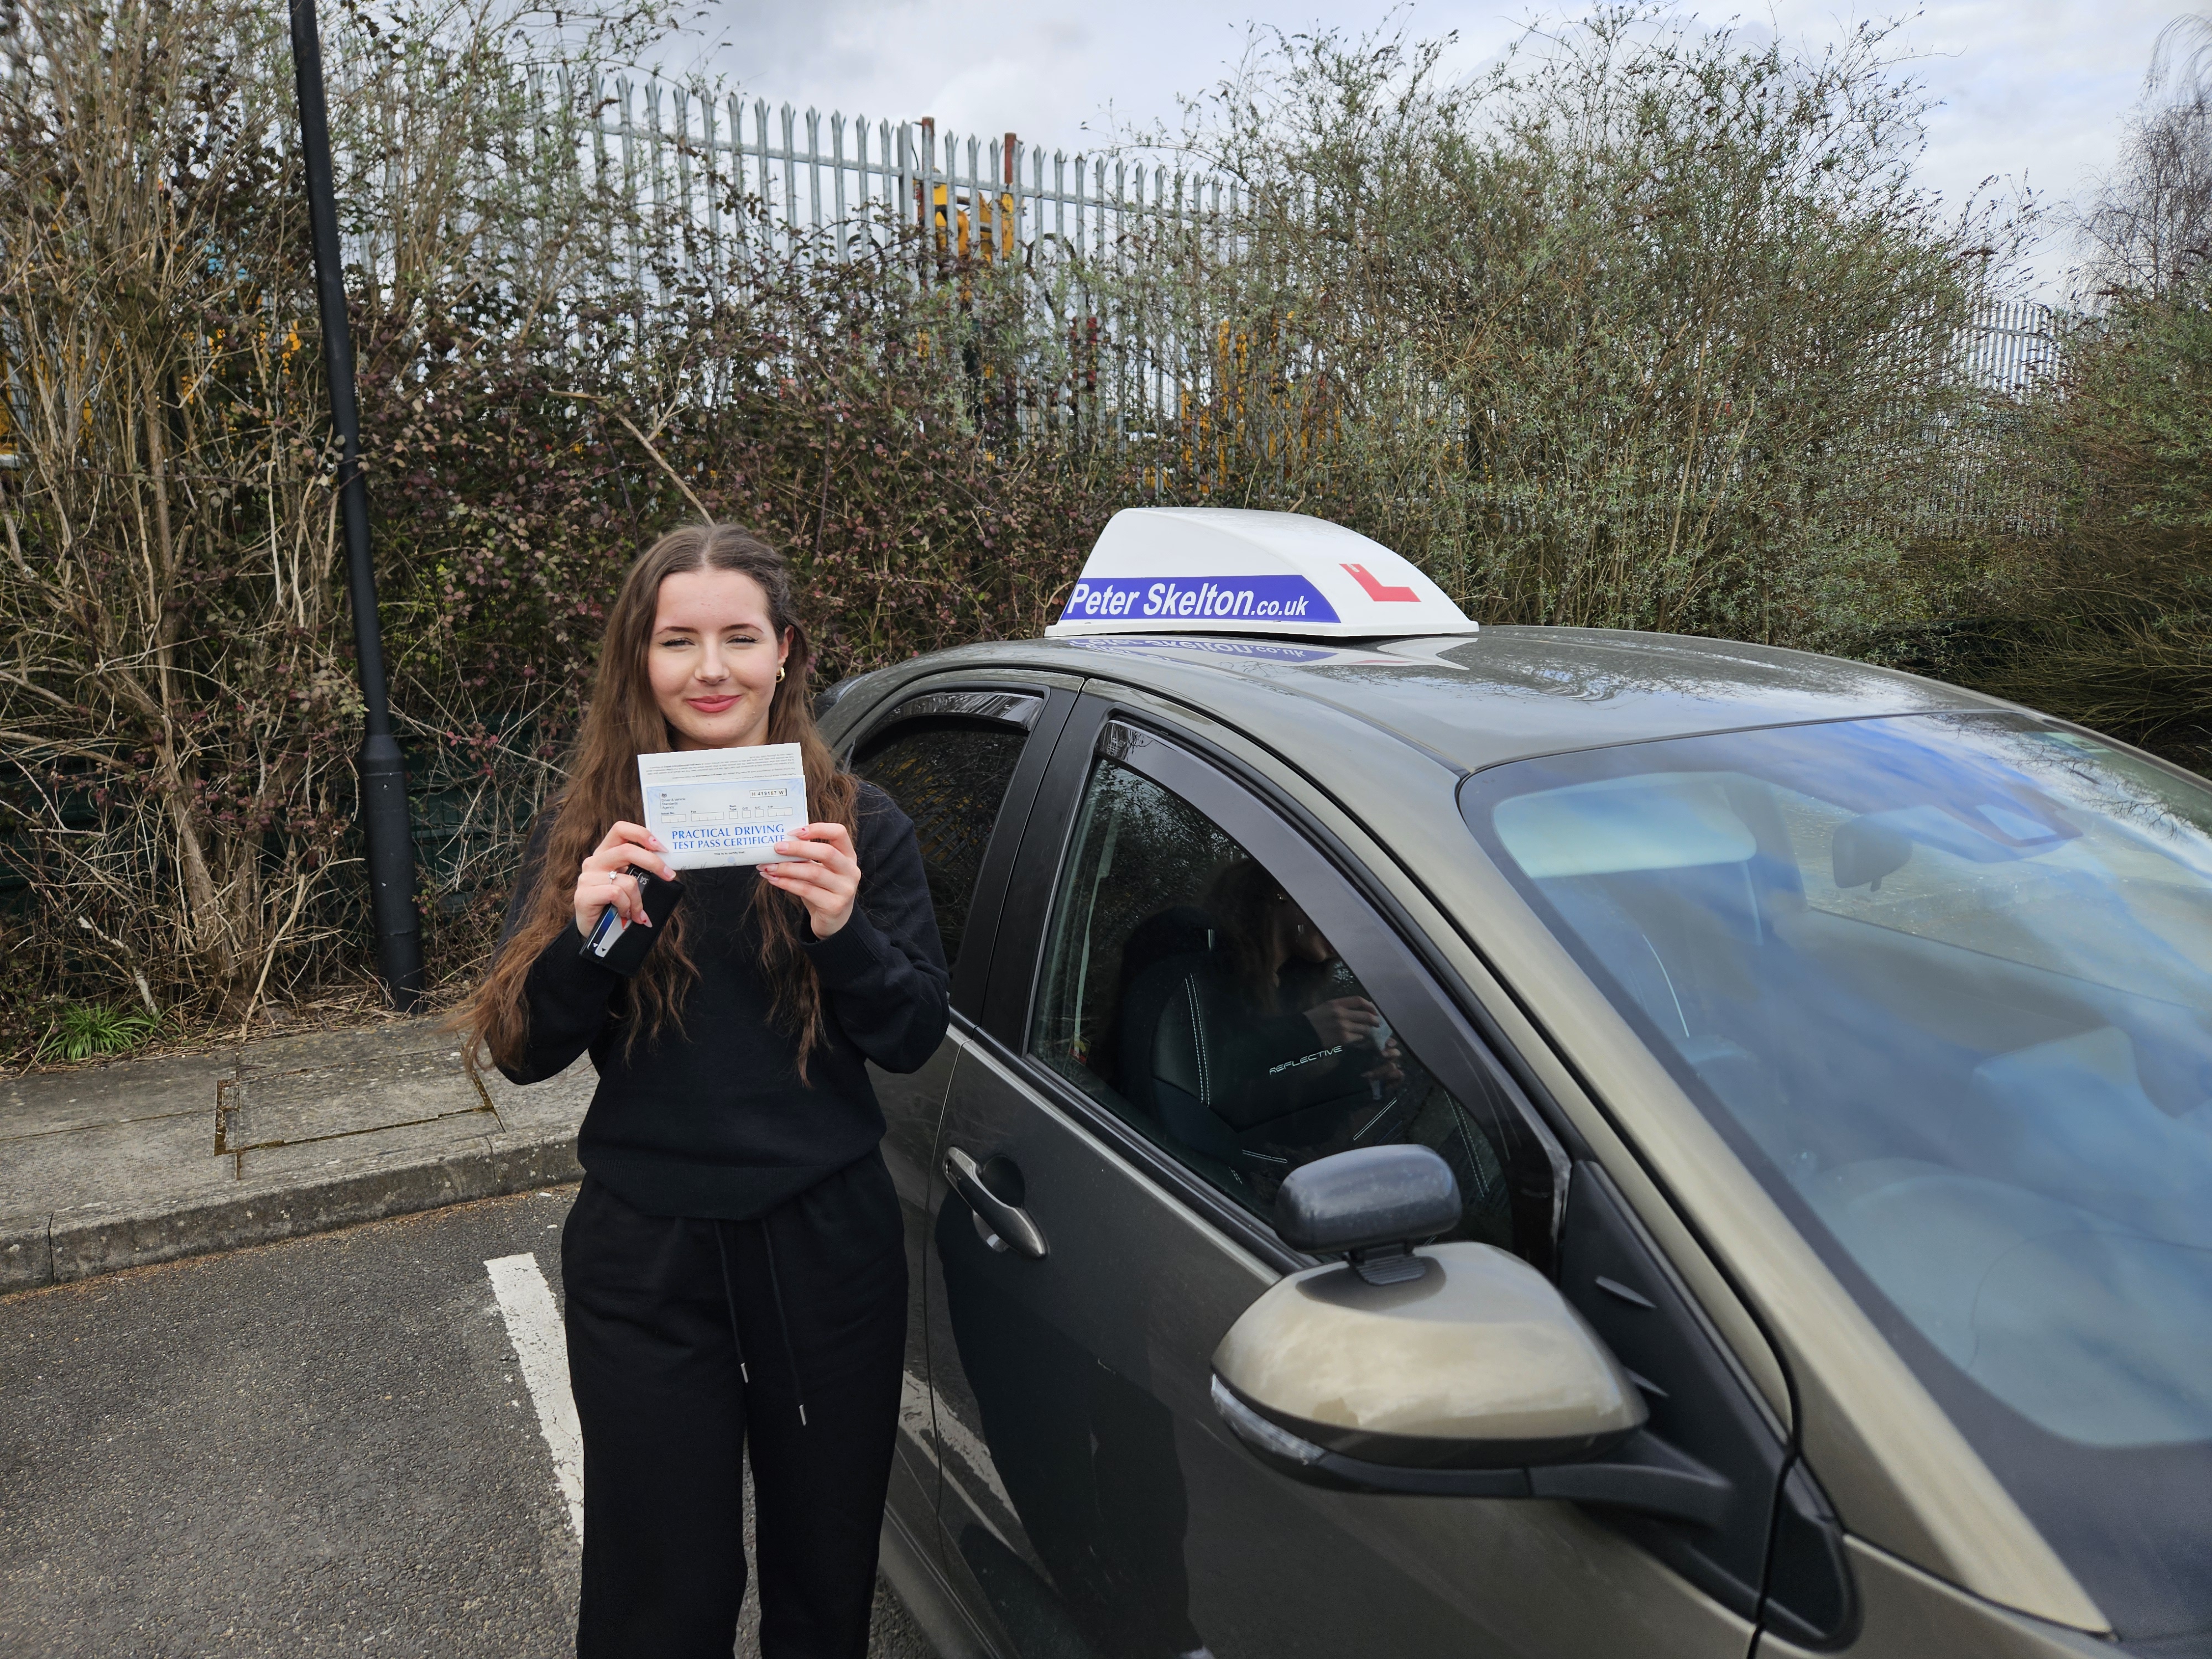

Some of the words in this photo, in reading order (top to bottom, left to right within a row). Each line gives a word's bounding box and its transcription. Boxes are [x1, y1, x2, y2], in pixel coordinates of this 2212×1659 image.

[1339, 564, 1421, 602] L
[1067, 583, 1140, 615] Peter
[1143, 582, 1310, 616] Skelton.co.uk
[672, 828, 731, 839] PRACTICAL
[735, 824, 784, 836] DRIVING
[672, 841, 695, 850] TEST
[698, 839, 721, 848] PASS
[724, 835, 785, 847] CERTIFICATE
[1269, 1045, 1343, 1074] REFLECTIVE
